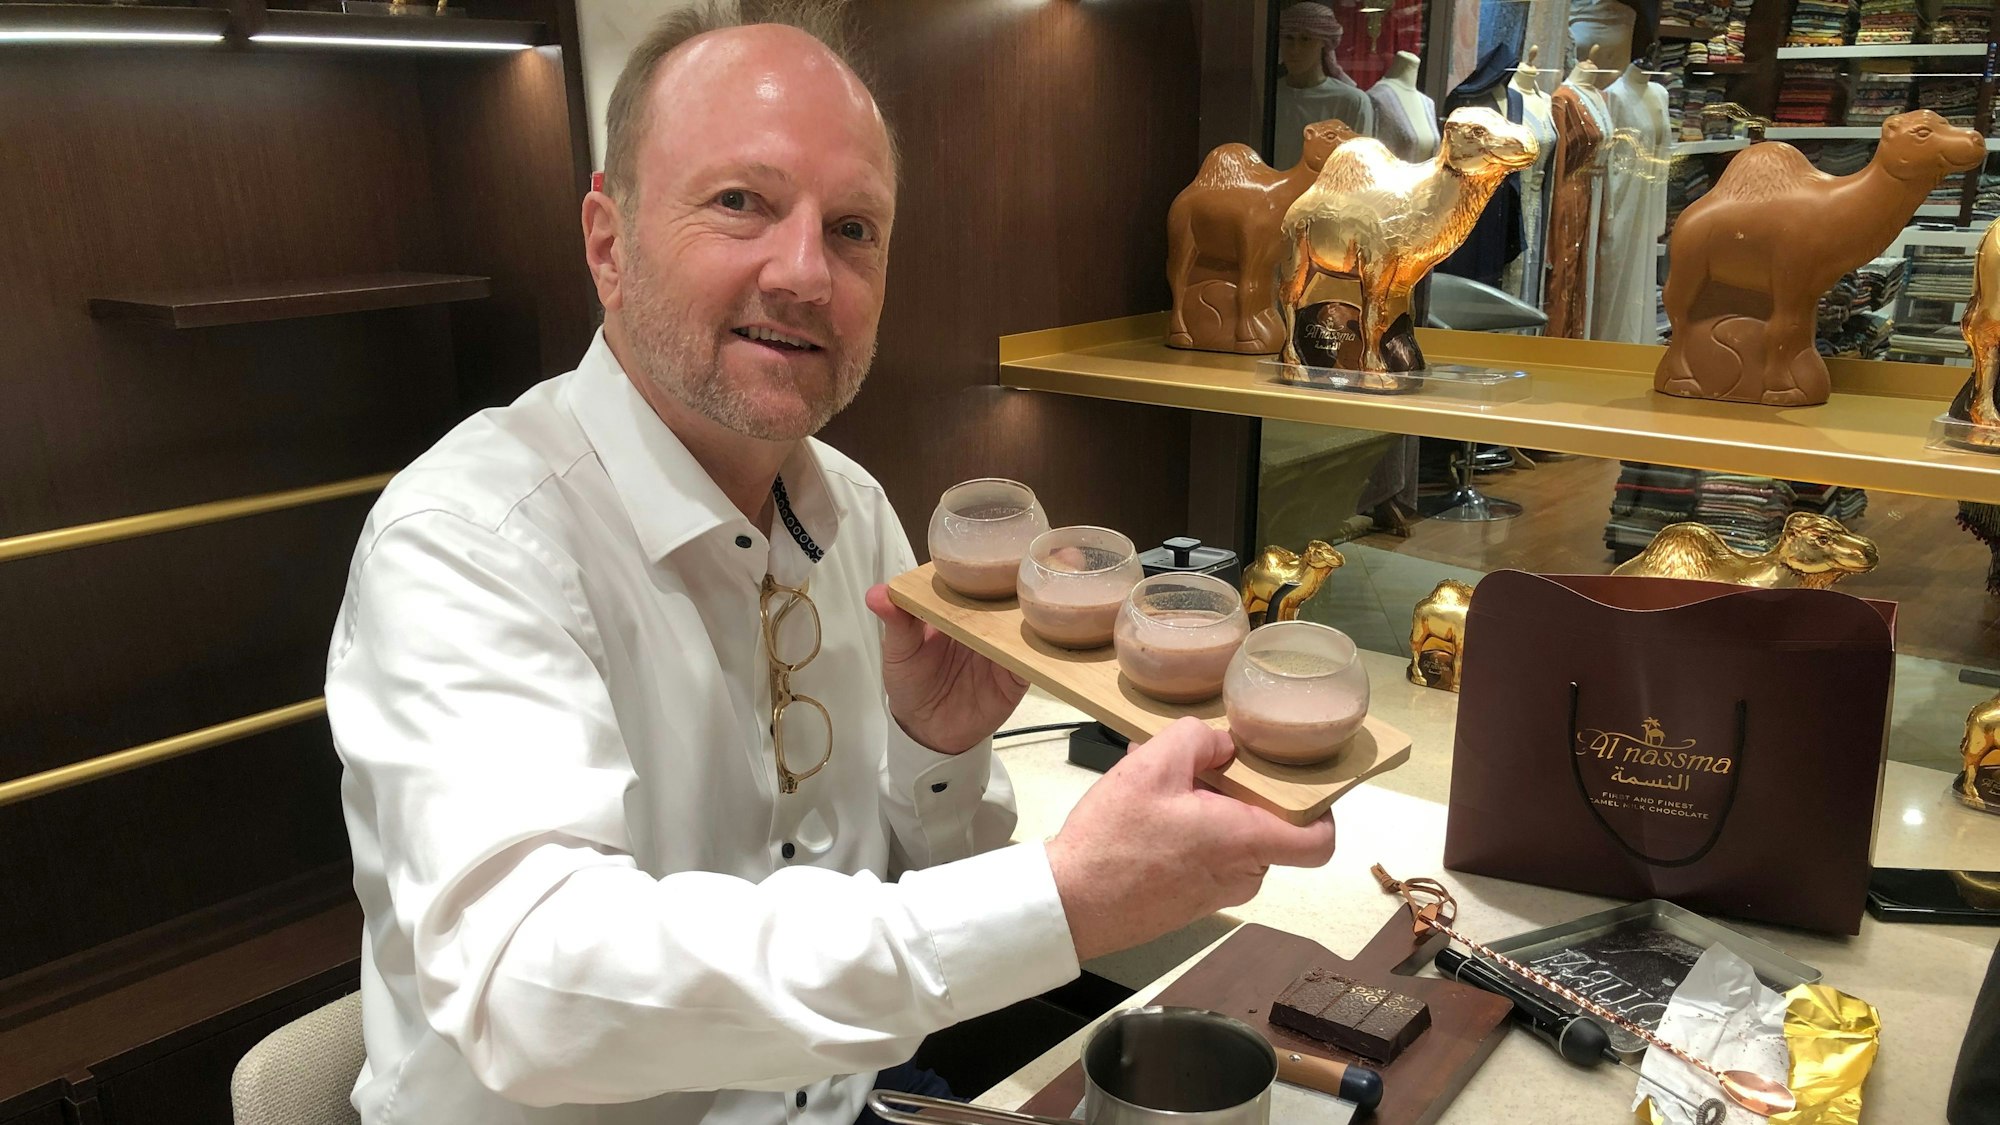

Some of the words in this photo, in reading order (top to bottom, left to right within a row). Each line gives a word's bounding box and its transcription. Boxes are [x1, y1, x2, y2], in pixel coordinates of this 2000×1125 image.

[1575, 729, 1620, 760] Al
[1622, 747, 1732, 774] nassma
[1611, 766, 1690, 791] النسمة
[1633, 796, 1655, 805] AND
[1657, 799, 1694, 810] FINEST
[1648, 806, 1710, 820] CHOCOLATE
